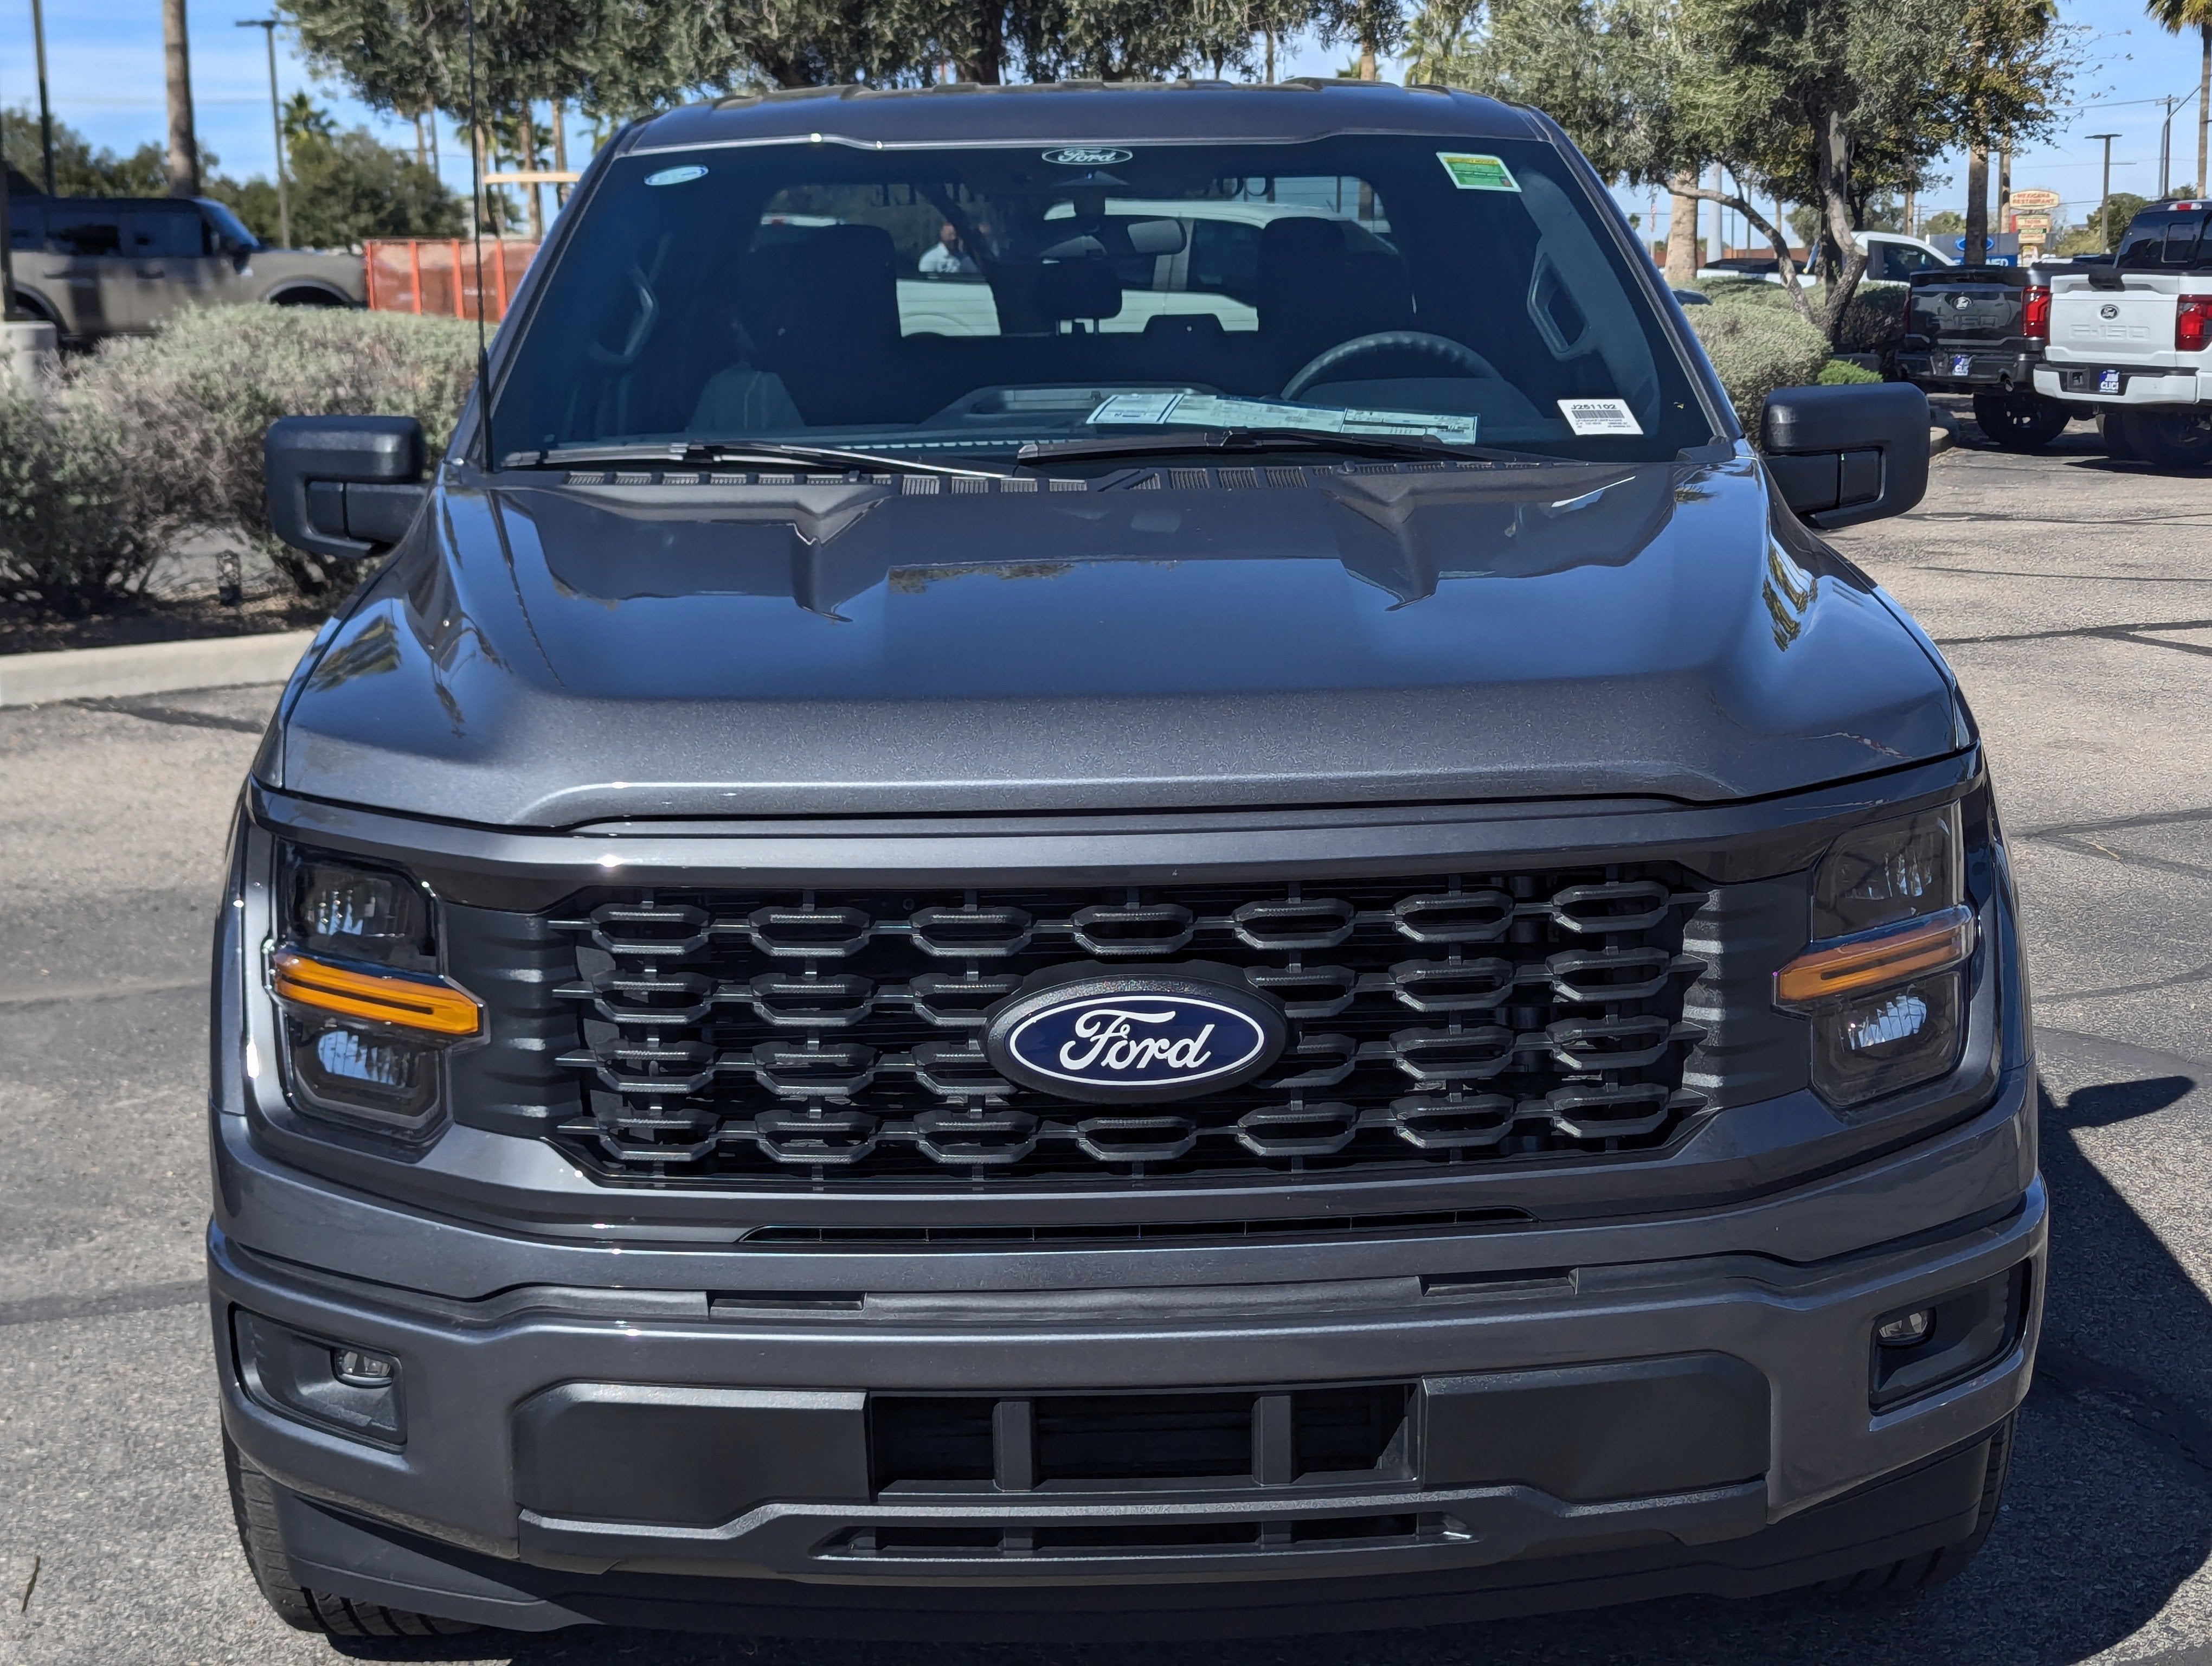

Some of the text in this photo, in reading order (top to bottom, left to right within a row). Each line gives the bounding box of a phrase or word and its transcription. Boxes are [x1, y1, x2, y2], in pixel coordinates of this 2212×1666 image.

[1058, 148, 1117, 162] Ford
[2069, 324, 2150, 341] F-150
[1059, 1009, 1215, 1071] Ford
